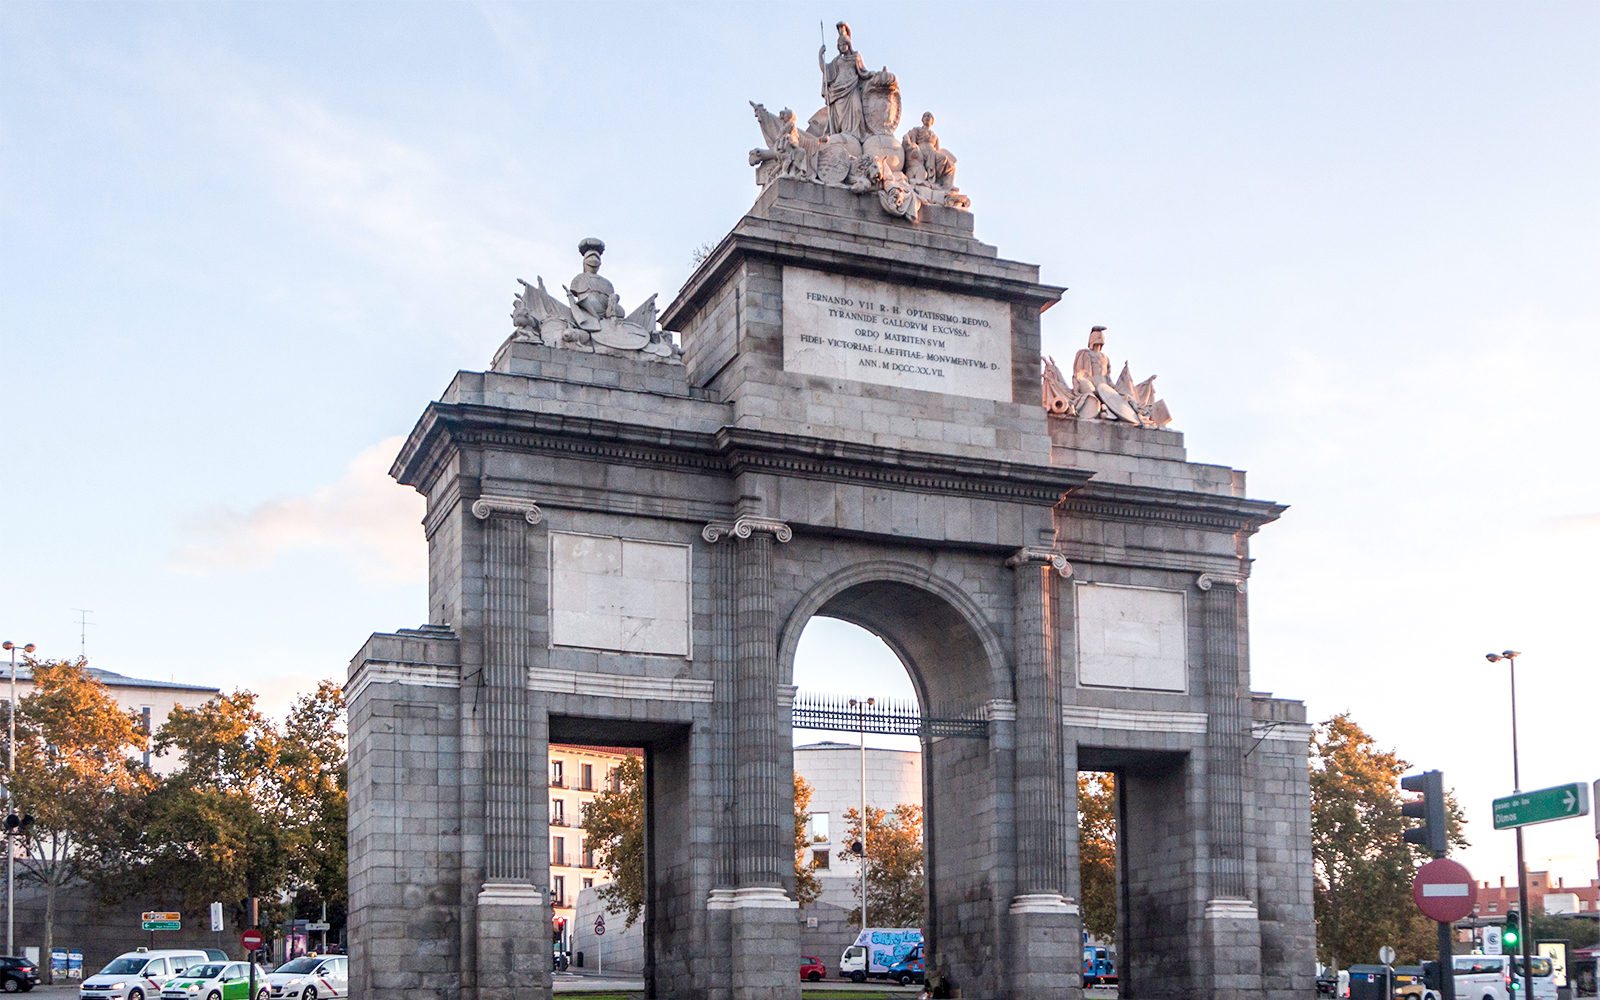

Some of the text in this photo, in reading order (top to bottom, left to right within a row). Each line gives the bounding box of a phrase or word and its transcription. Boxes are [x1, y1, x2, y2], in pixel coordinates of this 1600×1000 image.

[806, 292, 854, 306] FERNANDO
[859, 301, 873, 310] VII
[829, 309, 878, 324] TYRANNIDE
[882, 317, 928, 331] GALLORVM
[1495, 813, 1517, 824] Olmos
